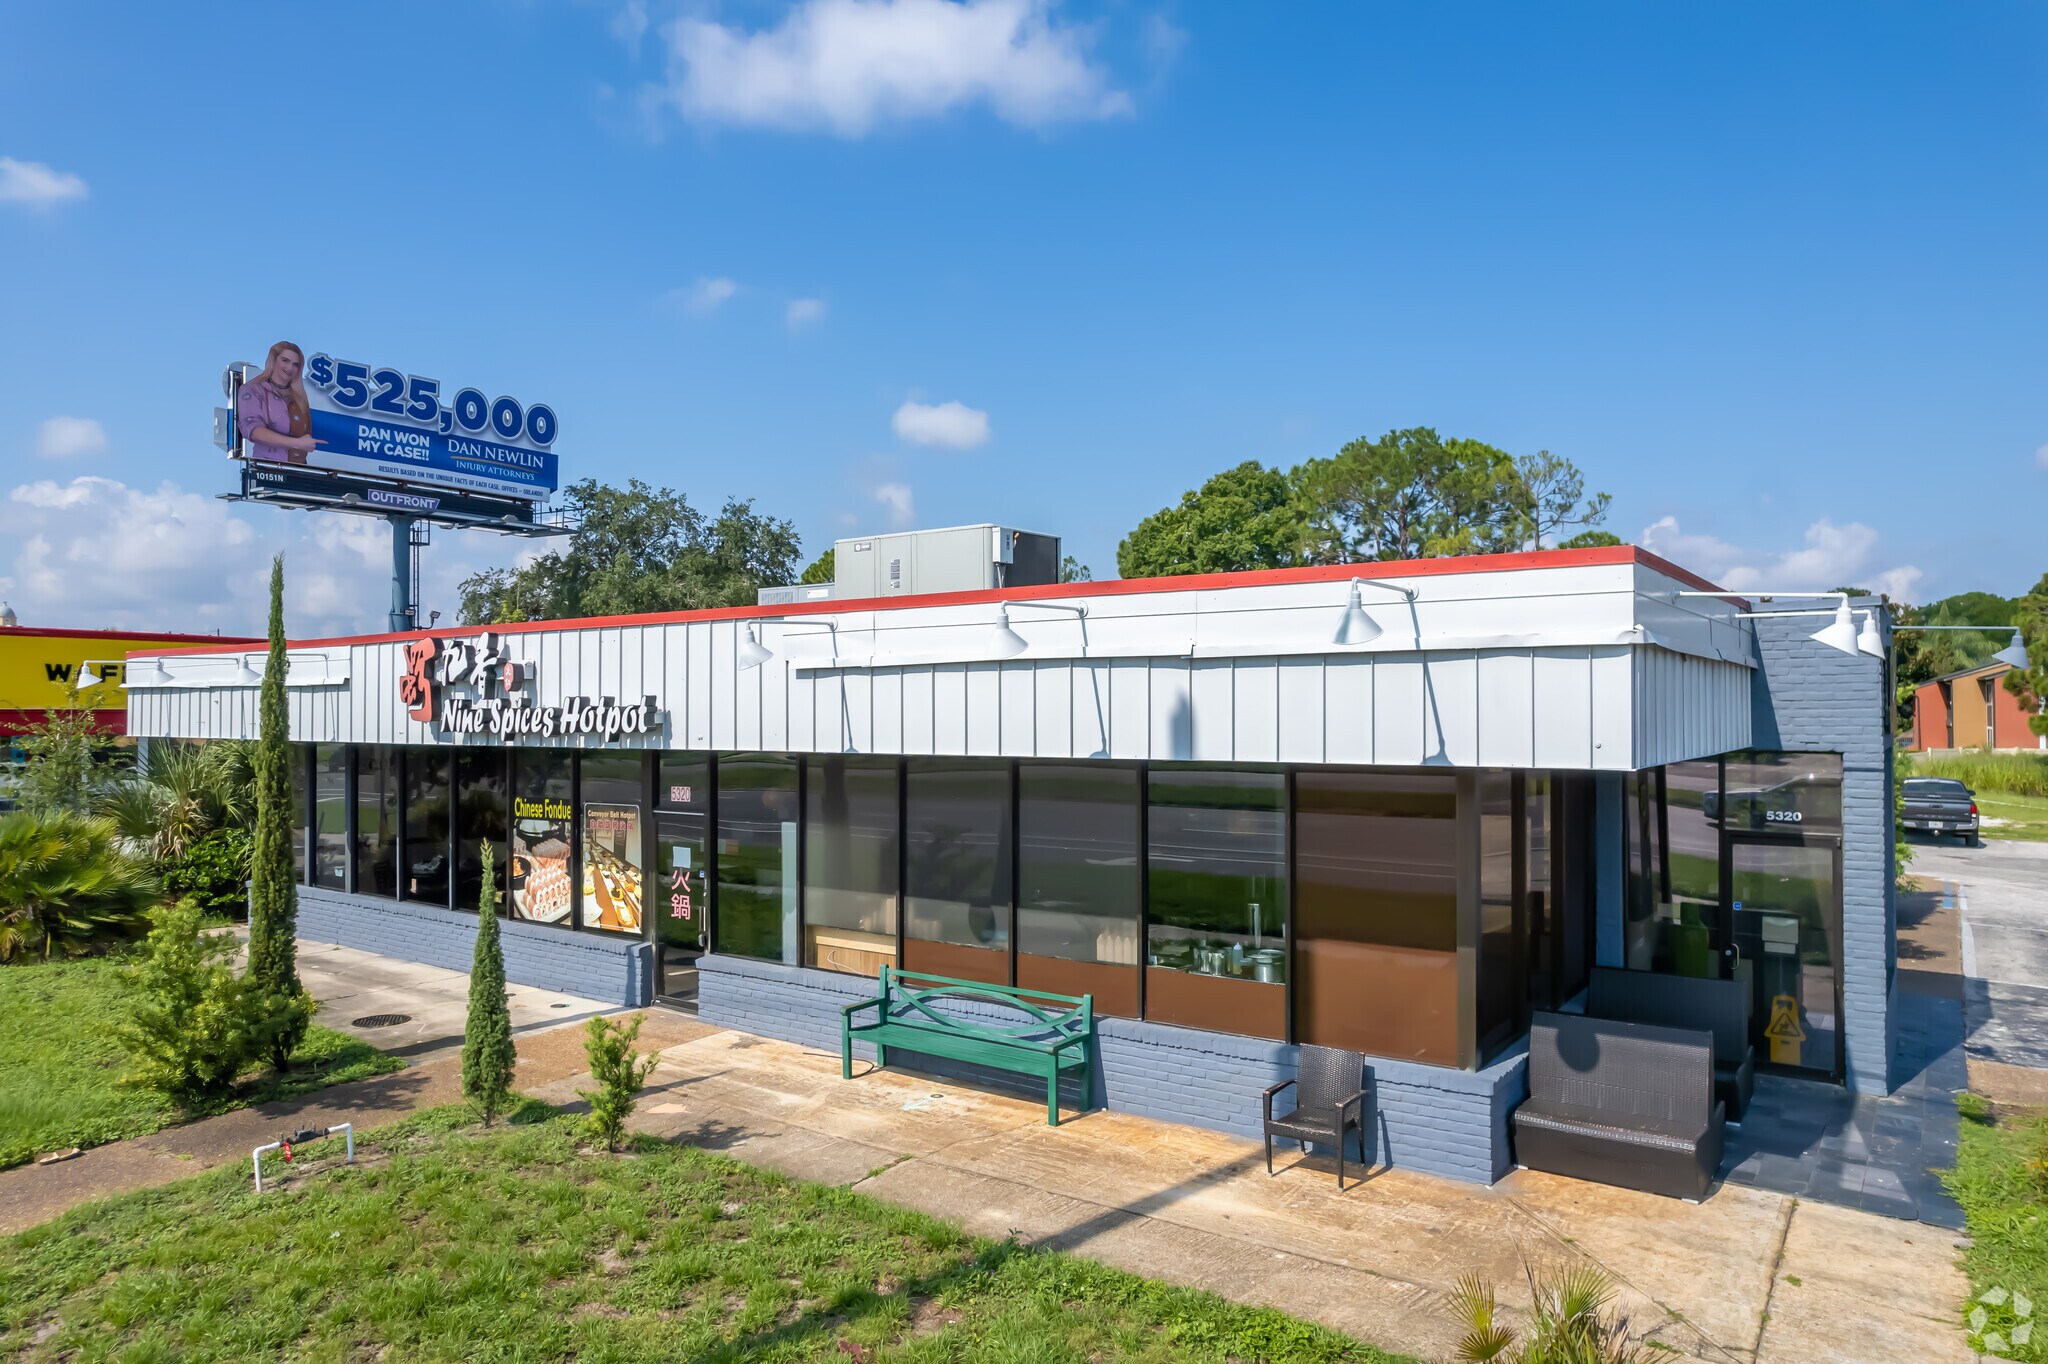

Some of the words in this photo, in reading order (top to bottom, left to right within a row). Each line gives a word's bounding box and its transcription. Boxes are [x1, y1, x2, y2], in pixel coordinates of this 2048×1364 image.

[305, 353, 558, 446] $525,000
[358, 424, 391, 441] DAN
[393, 430, 430, 448] WON
[358, 438, 381, 454] MY
[383, 443, 430, 461] CASE!!
[447, 438, 481, 457] DAN
[485, 446, 544, 469] NEWLIN
[256, 472, 284, 482] 10151N
[378, 465, 400, 475] RESULTS
[400, 468, 417, 477] BASED
[426, 472, 435, 480] THE
[454, 476, 468, 485] FACTS
[456, 460, 487, 472] INJURY
[488, 466, 535, 481] ATTORNEYS
[371, 491, 436, 509] OUTFRONT
[440, 698, 484, 733] Nine
[489, 697, 555, 738] Spices
[560, 695, 648, 742] Hotpot
[671, 786, 691, 802] 5320
[514, 797, 543, 818] Chinese
[544, 798, 572, 820] Fondue
[1766, 810, 1802, 822] 5320
[671, 868, 691, 920] 火鍋
